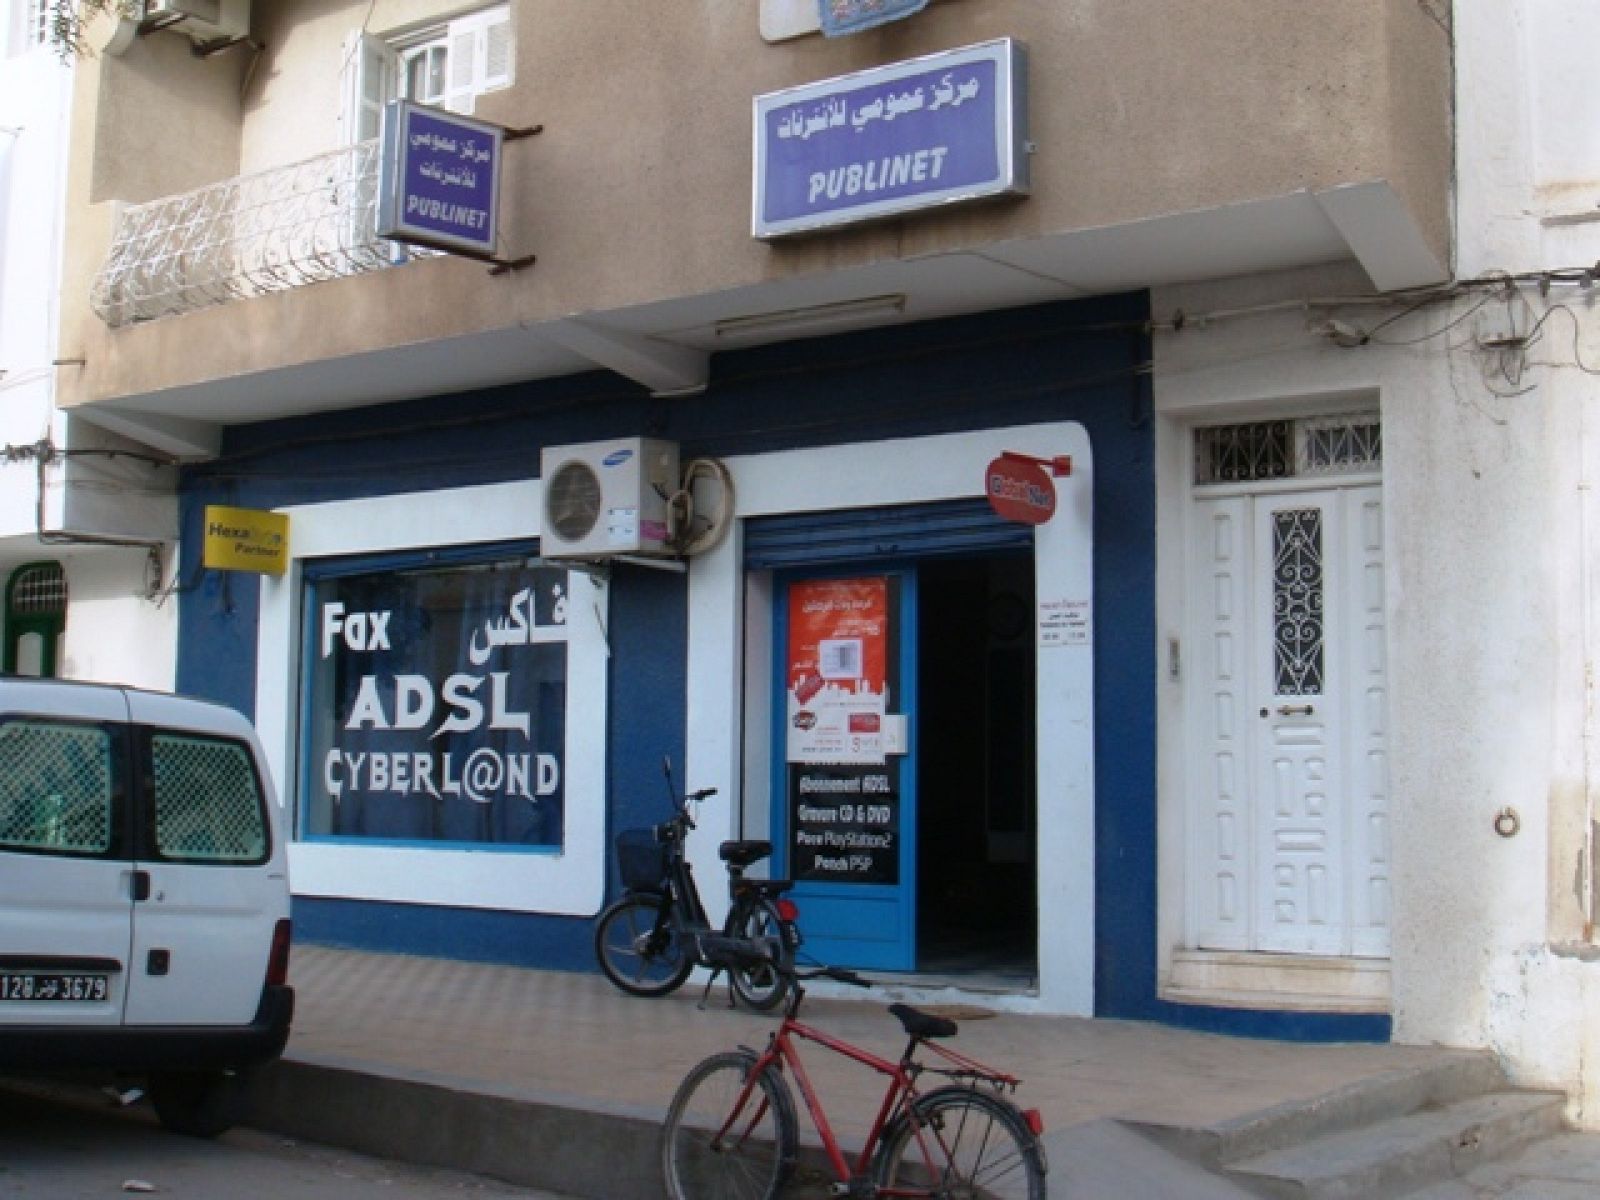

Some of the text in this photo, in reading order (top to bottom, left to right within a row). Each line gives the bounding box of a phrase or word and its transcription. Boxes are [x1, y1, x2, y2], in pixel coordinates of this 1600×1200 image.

[852, 87, 924, 132] عمومي
[928, 74, 980, 111] مركز
[459, 139, 491, 163] مركز
[809, 147, 948, 203] PUBLINET
[407, 194, 489, 229] PUBLINET
[322, 602, 392, 659] Fax
[469, 582, 568, 665] فاكس
[344, 672, 531, 740] ADSL
[324, 747, 559, 803] CYBERL@ND
[857, 804, 866, 823] &
[867, 804, 891, 823] DVD
